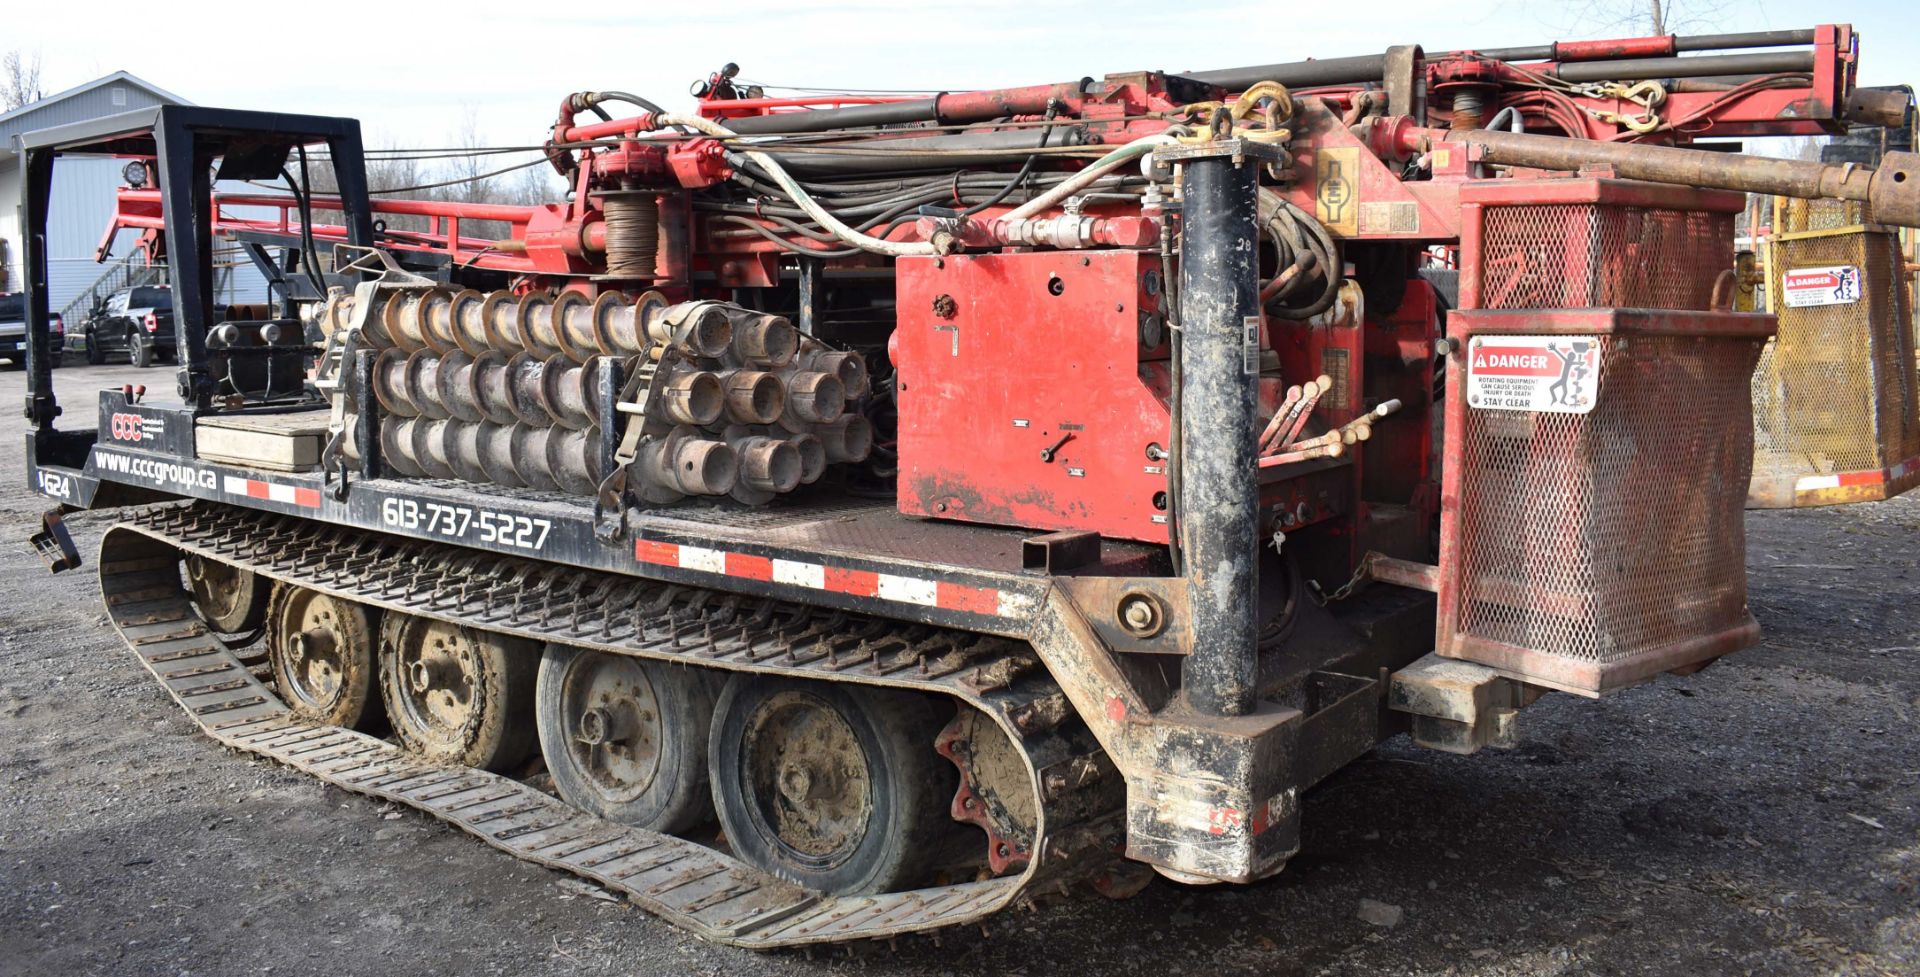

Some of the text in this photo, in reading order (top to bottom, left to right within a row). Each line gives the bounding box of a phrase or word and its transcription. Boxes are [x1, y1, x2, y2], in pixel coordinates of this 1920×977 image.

[1795, 277, 1831, 287] DANGER
[1489, 354, 1548, 369] DANGER
[1483, 398, 1531, 408] STAY CLEAR
[112, 412, 142, 441] CCC
[95, 451, 217, 490] www.cccgroup.ca
[383, 497, 551, 550] 613-737-5227
